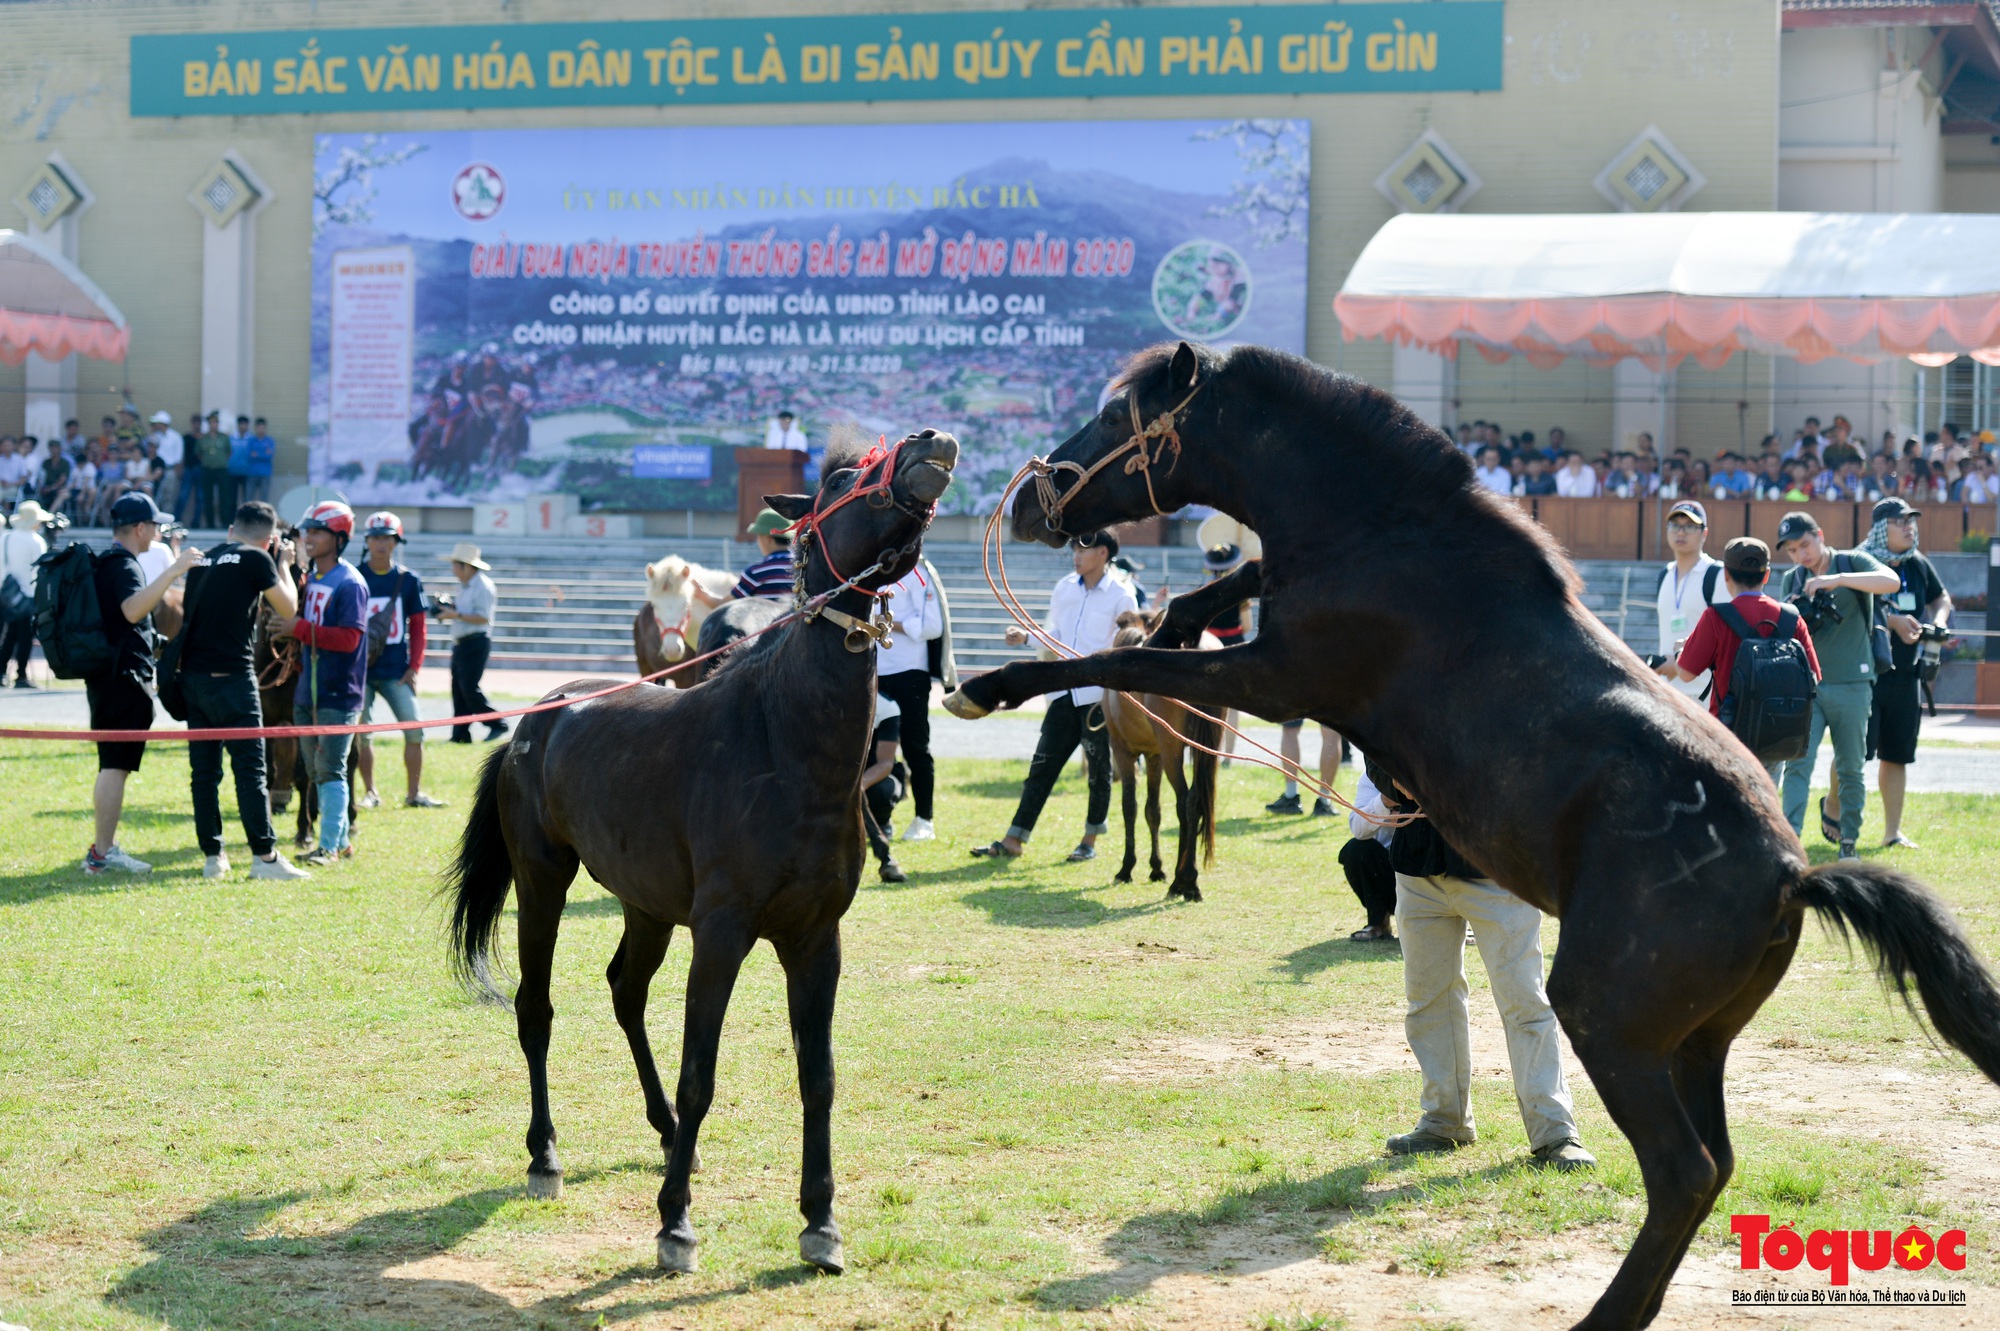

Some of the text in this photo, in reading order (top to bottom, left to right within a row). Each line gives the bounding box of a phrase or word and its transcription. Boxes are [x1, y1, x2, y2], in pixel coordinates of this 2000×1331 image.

[184, 18, 1438, 97] BẢN SẮC VĂN HÓA DÂN TỘC LÀ DI SẢN QÚY CẦN PHẢI GIỮ GÌN
[608, 190, 662, 210] BAN
[672, 182, 747, 210] NHÂN
[757, 182, 815, 210] DÂN
[825, 180, 922, 214] HUYỆN
[932, 175, 991, 209] BẮC
[999, 179, 1040, 208] HÀ
[470, 225, 1135, 285] GIẢI ĐUA NGỰA TRUYỀN THỐNG BẮC HÀ MỞ RỘNG NĂM 2020
[550, 286, 1046, 319] CÔNG BỐ QUYẾT ĐỊNH CỦA UBND TỈNH LÀO CAI
[512, 313, 1085, 350] CÔNG NHẬN HUYỆN BẮC HÀ LÀ KHU DU LỊCH CẤP TỈNH
[492, 508, 509, 528] 2
[540, 500, 551, 530] 1
[586, 516, 606, 537] 3
